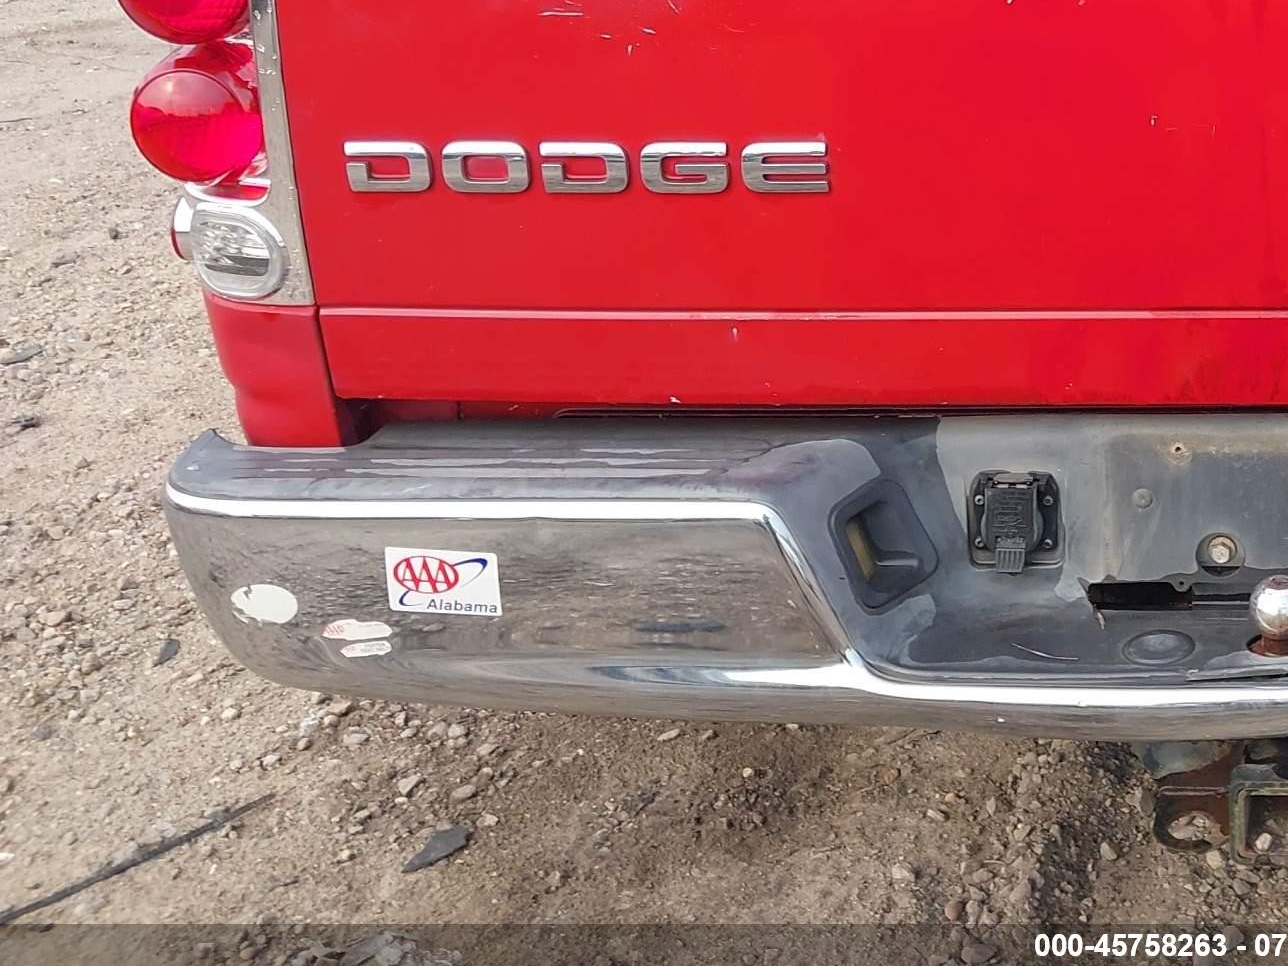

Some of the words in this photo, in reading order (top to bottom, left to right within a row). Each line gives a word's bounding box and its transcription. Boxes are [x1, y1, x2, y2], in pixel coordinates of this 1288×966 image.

[343, 141, 830, 193] DODGE
[398, 555, 456, 594] AAA
[426, 598, 498, 614] Alabama
